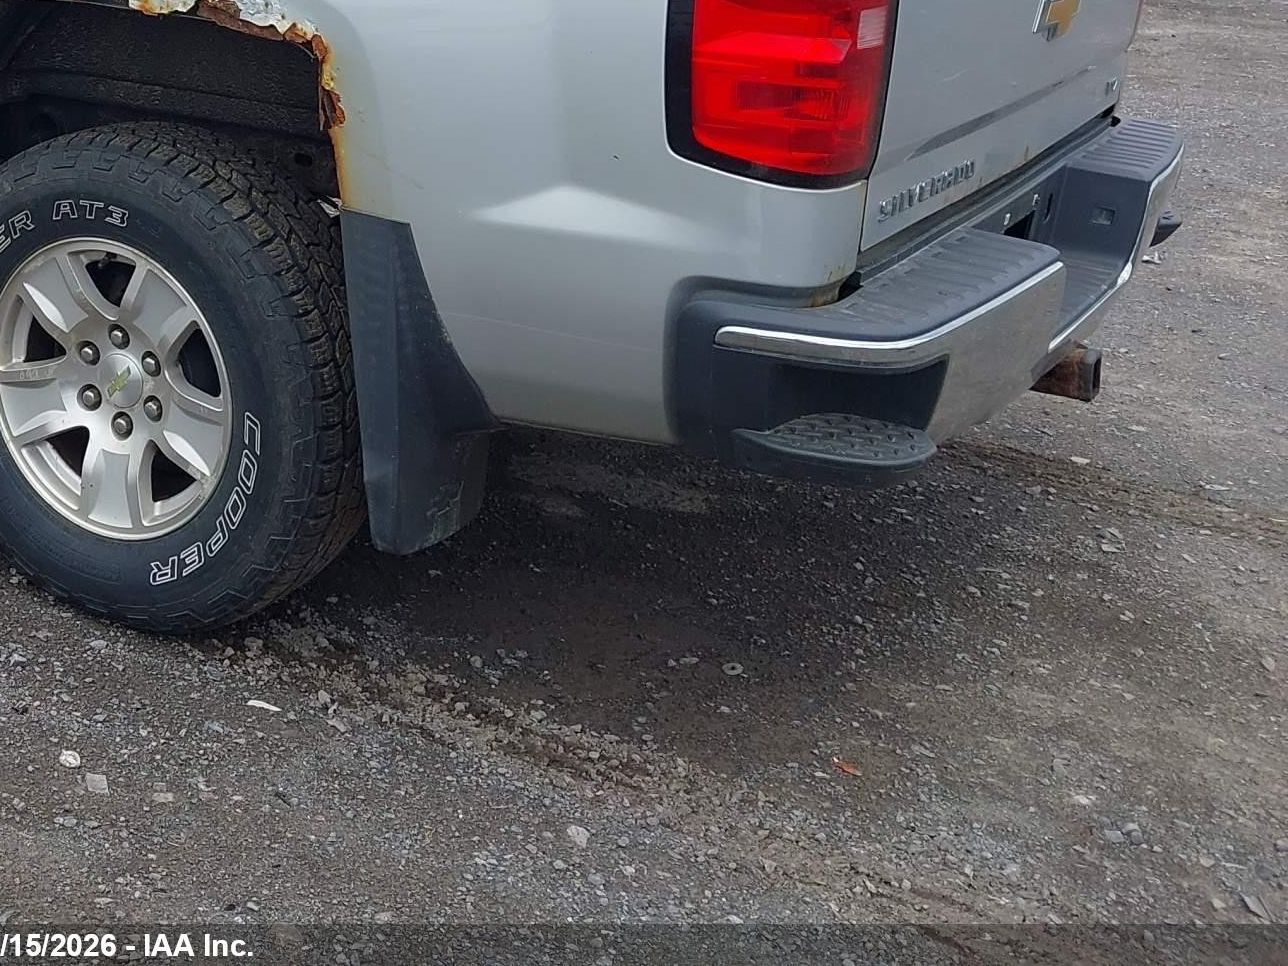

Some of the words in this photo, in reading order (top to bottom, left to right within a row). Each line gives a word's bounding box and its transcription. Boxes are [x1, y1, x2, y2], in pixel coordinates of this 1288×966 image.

[52, 199, 130, 228] AT3
[877, 159, 975, 223] SILVERADO
[149, 410, 261, 586] COOPER
